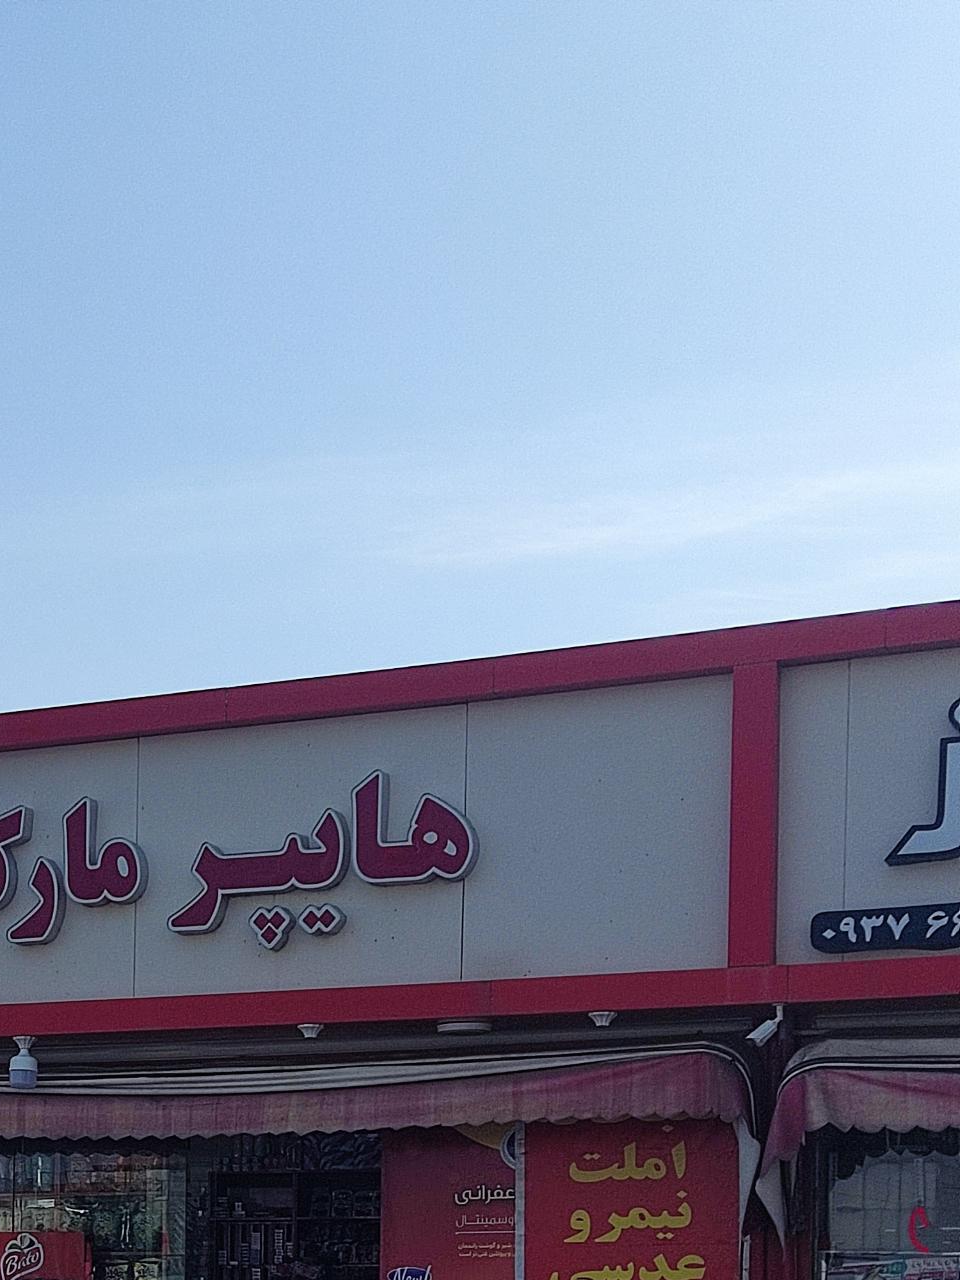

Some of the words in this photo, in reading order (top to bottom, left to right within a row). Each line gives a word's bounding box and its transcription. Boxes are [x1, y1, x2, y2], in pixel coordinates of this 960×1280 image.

[166, 769, 480, 951] هایپر
[569, 1140, 687, 1183] املت
[454, 1184, 515, 1206] عفرانی
[5, 1249, 40, 1275] Bato
